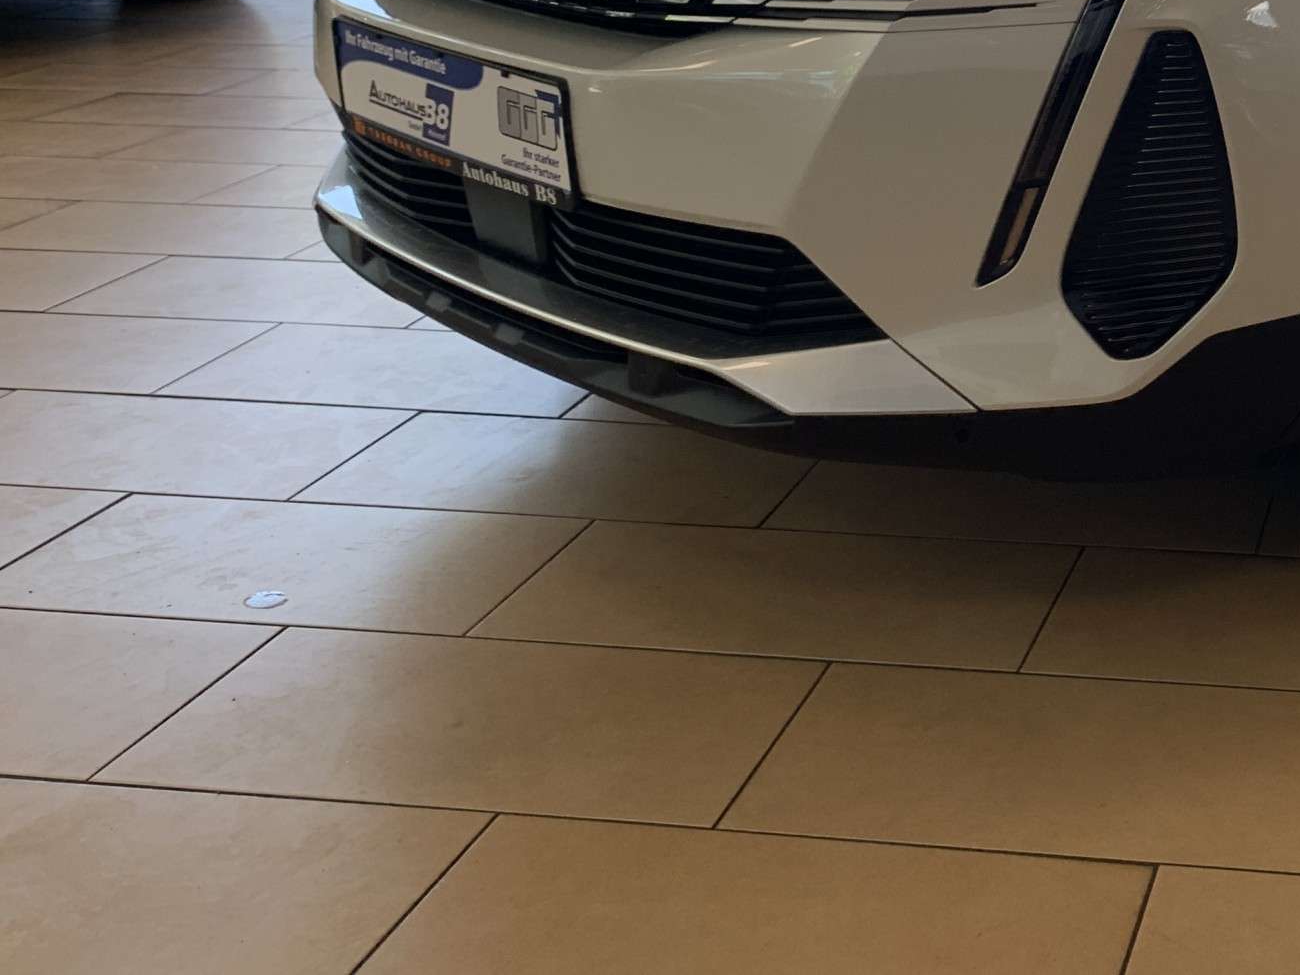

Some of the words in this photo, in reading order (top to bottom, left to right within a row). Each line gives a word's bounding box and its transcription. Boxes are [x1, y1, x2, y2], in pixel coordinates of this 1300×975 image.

[356, 34, 394, 61] Fahrzeug
[394, 46, 409, 63] mit
[409, 50, 447, 75] Garantie
[462, 161, 529, 197] Autohaus
